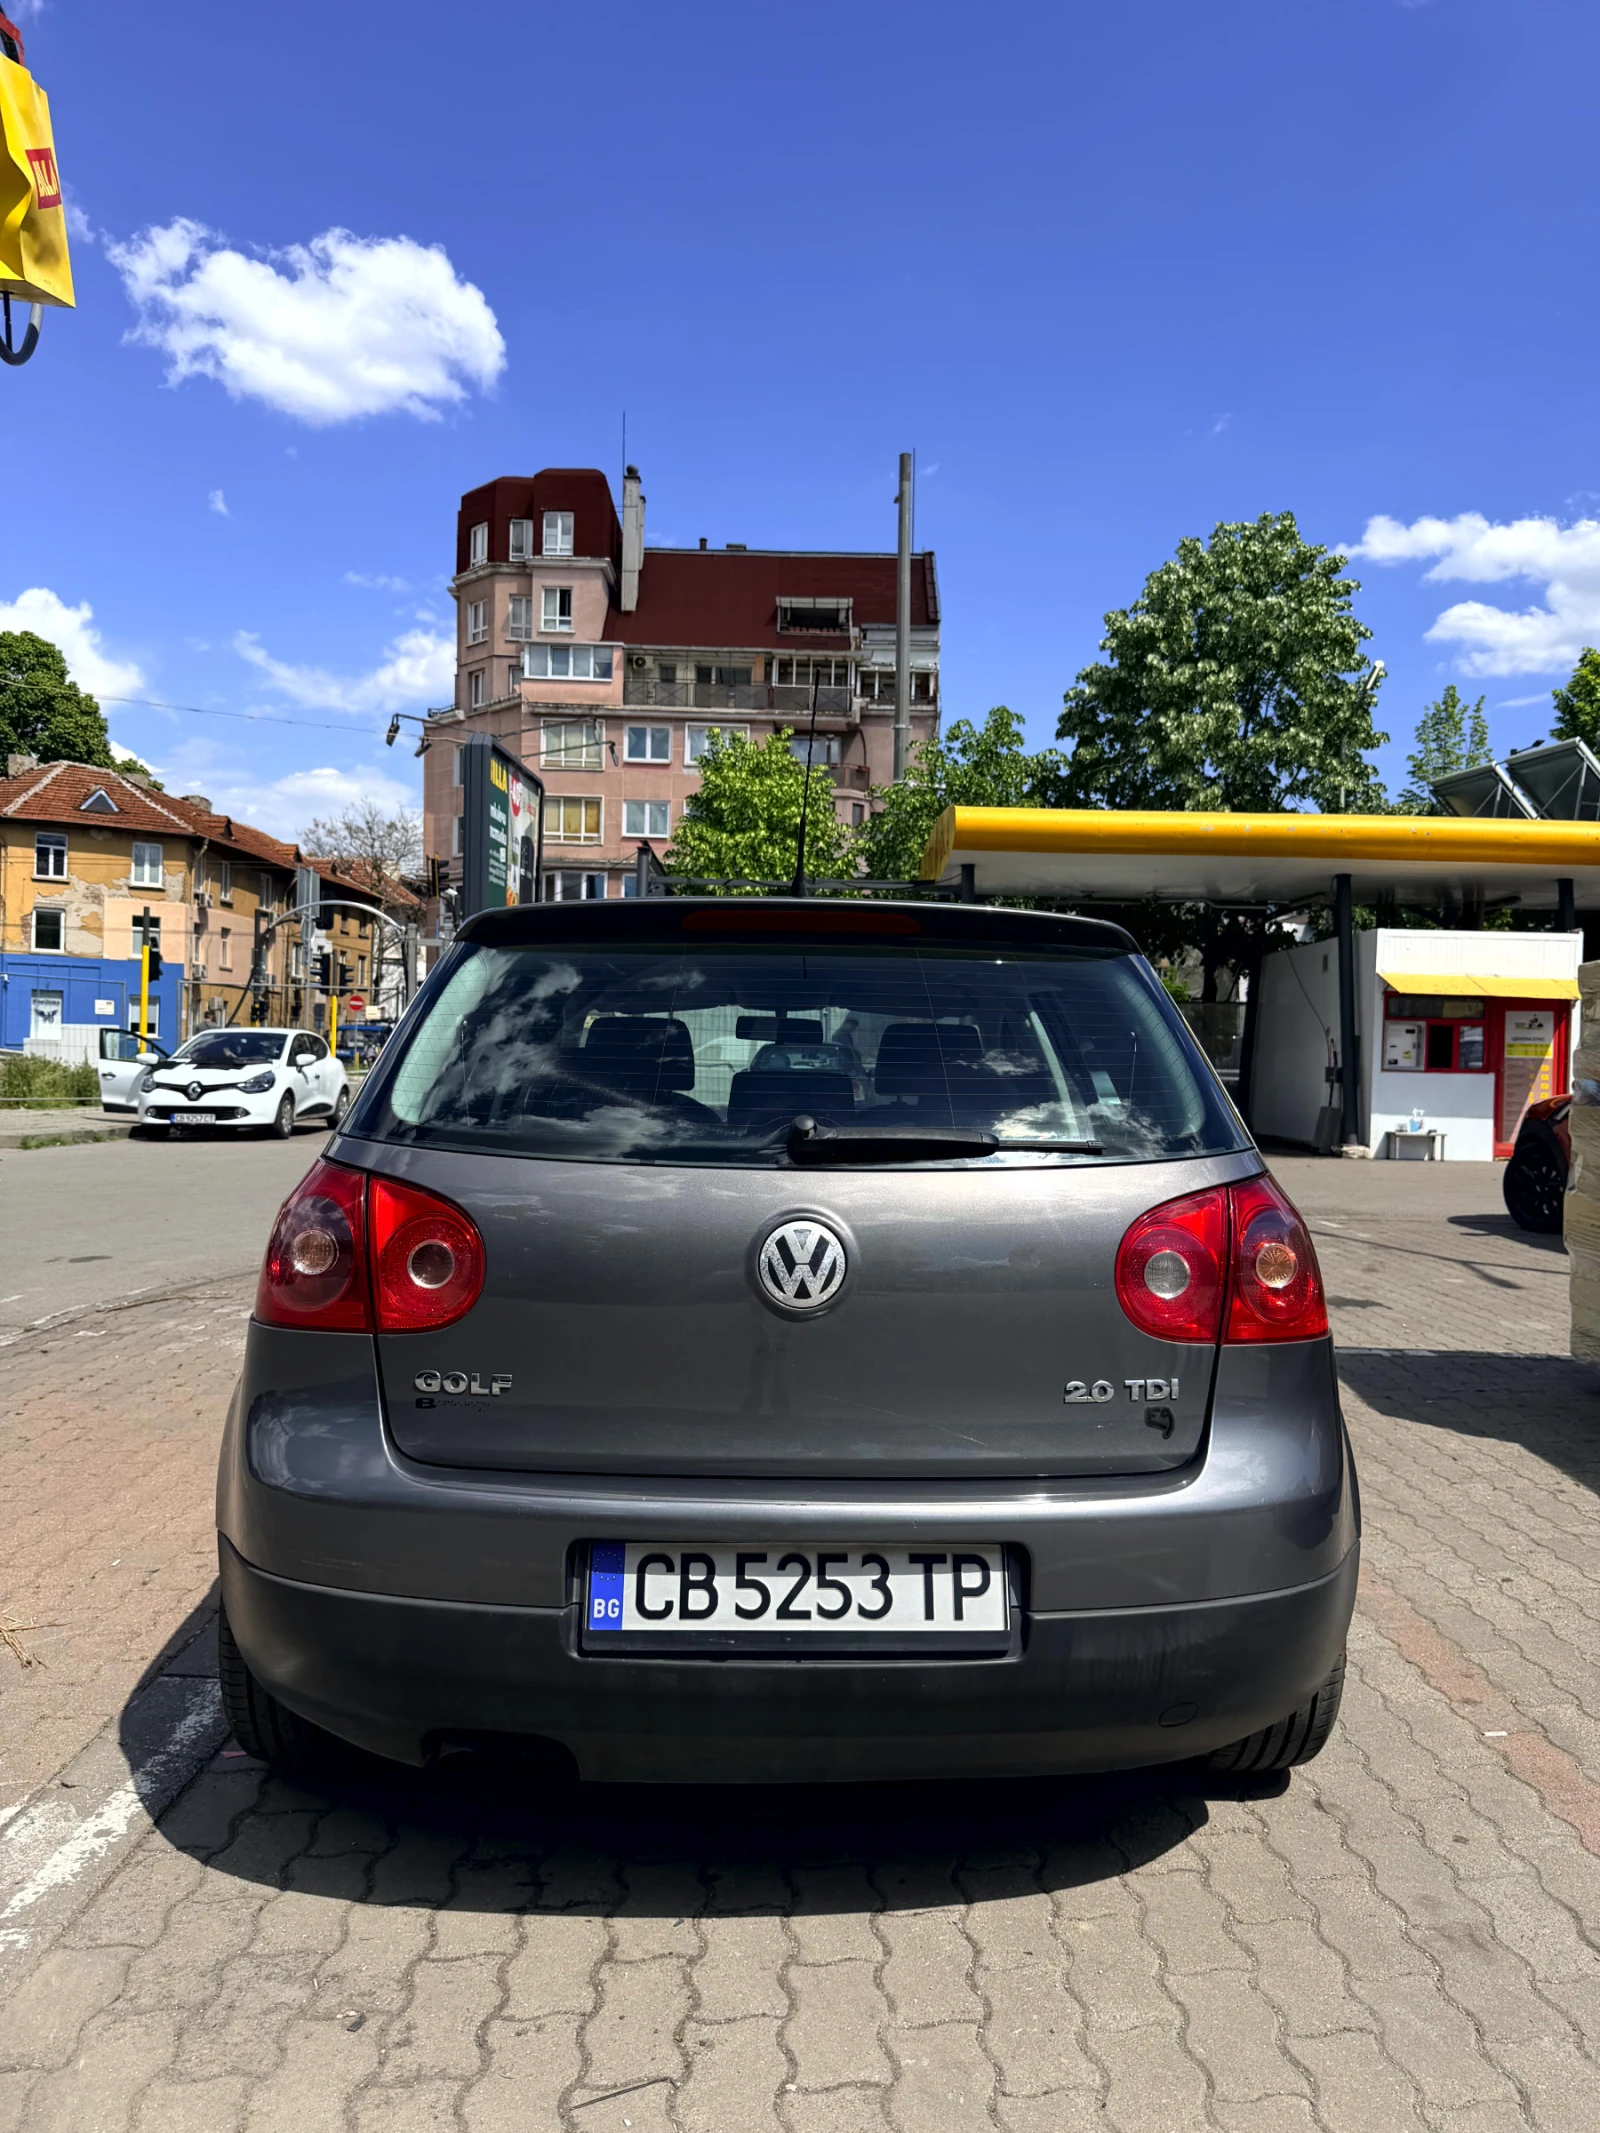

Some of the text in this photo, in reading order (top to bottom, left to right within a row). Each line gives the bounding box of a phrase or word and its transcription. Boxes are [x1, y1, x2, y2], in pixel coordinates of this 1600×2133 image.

[414, 1369, 512, 1395] GOLF
[1124, 1378, 1179, 1401] TDI
[636, 1553, 991, 1621] CB 5253 TP
[593, 1598, 620, 1618] BG
